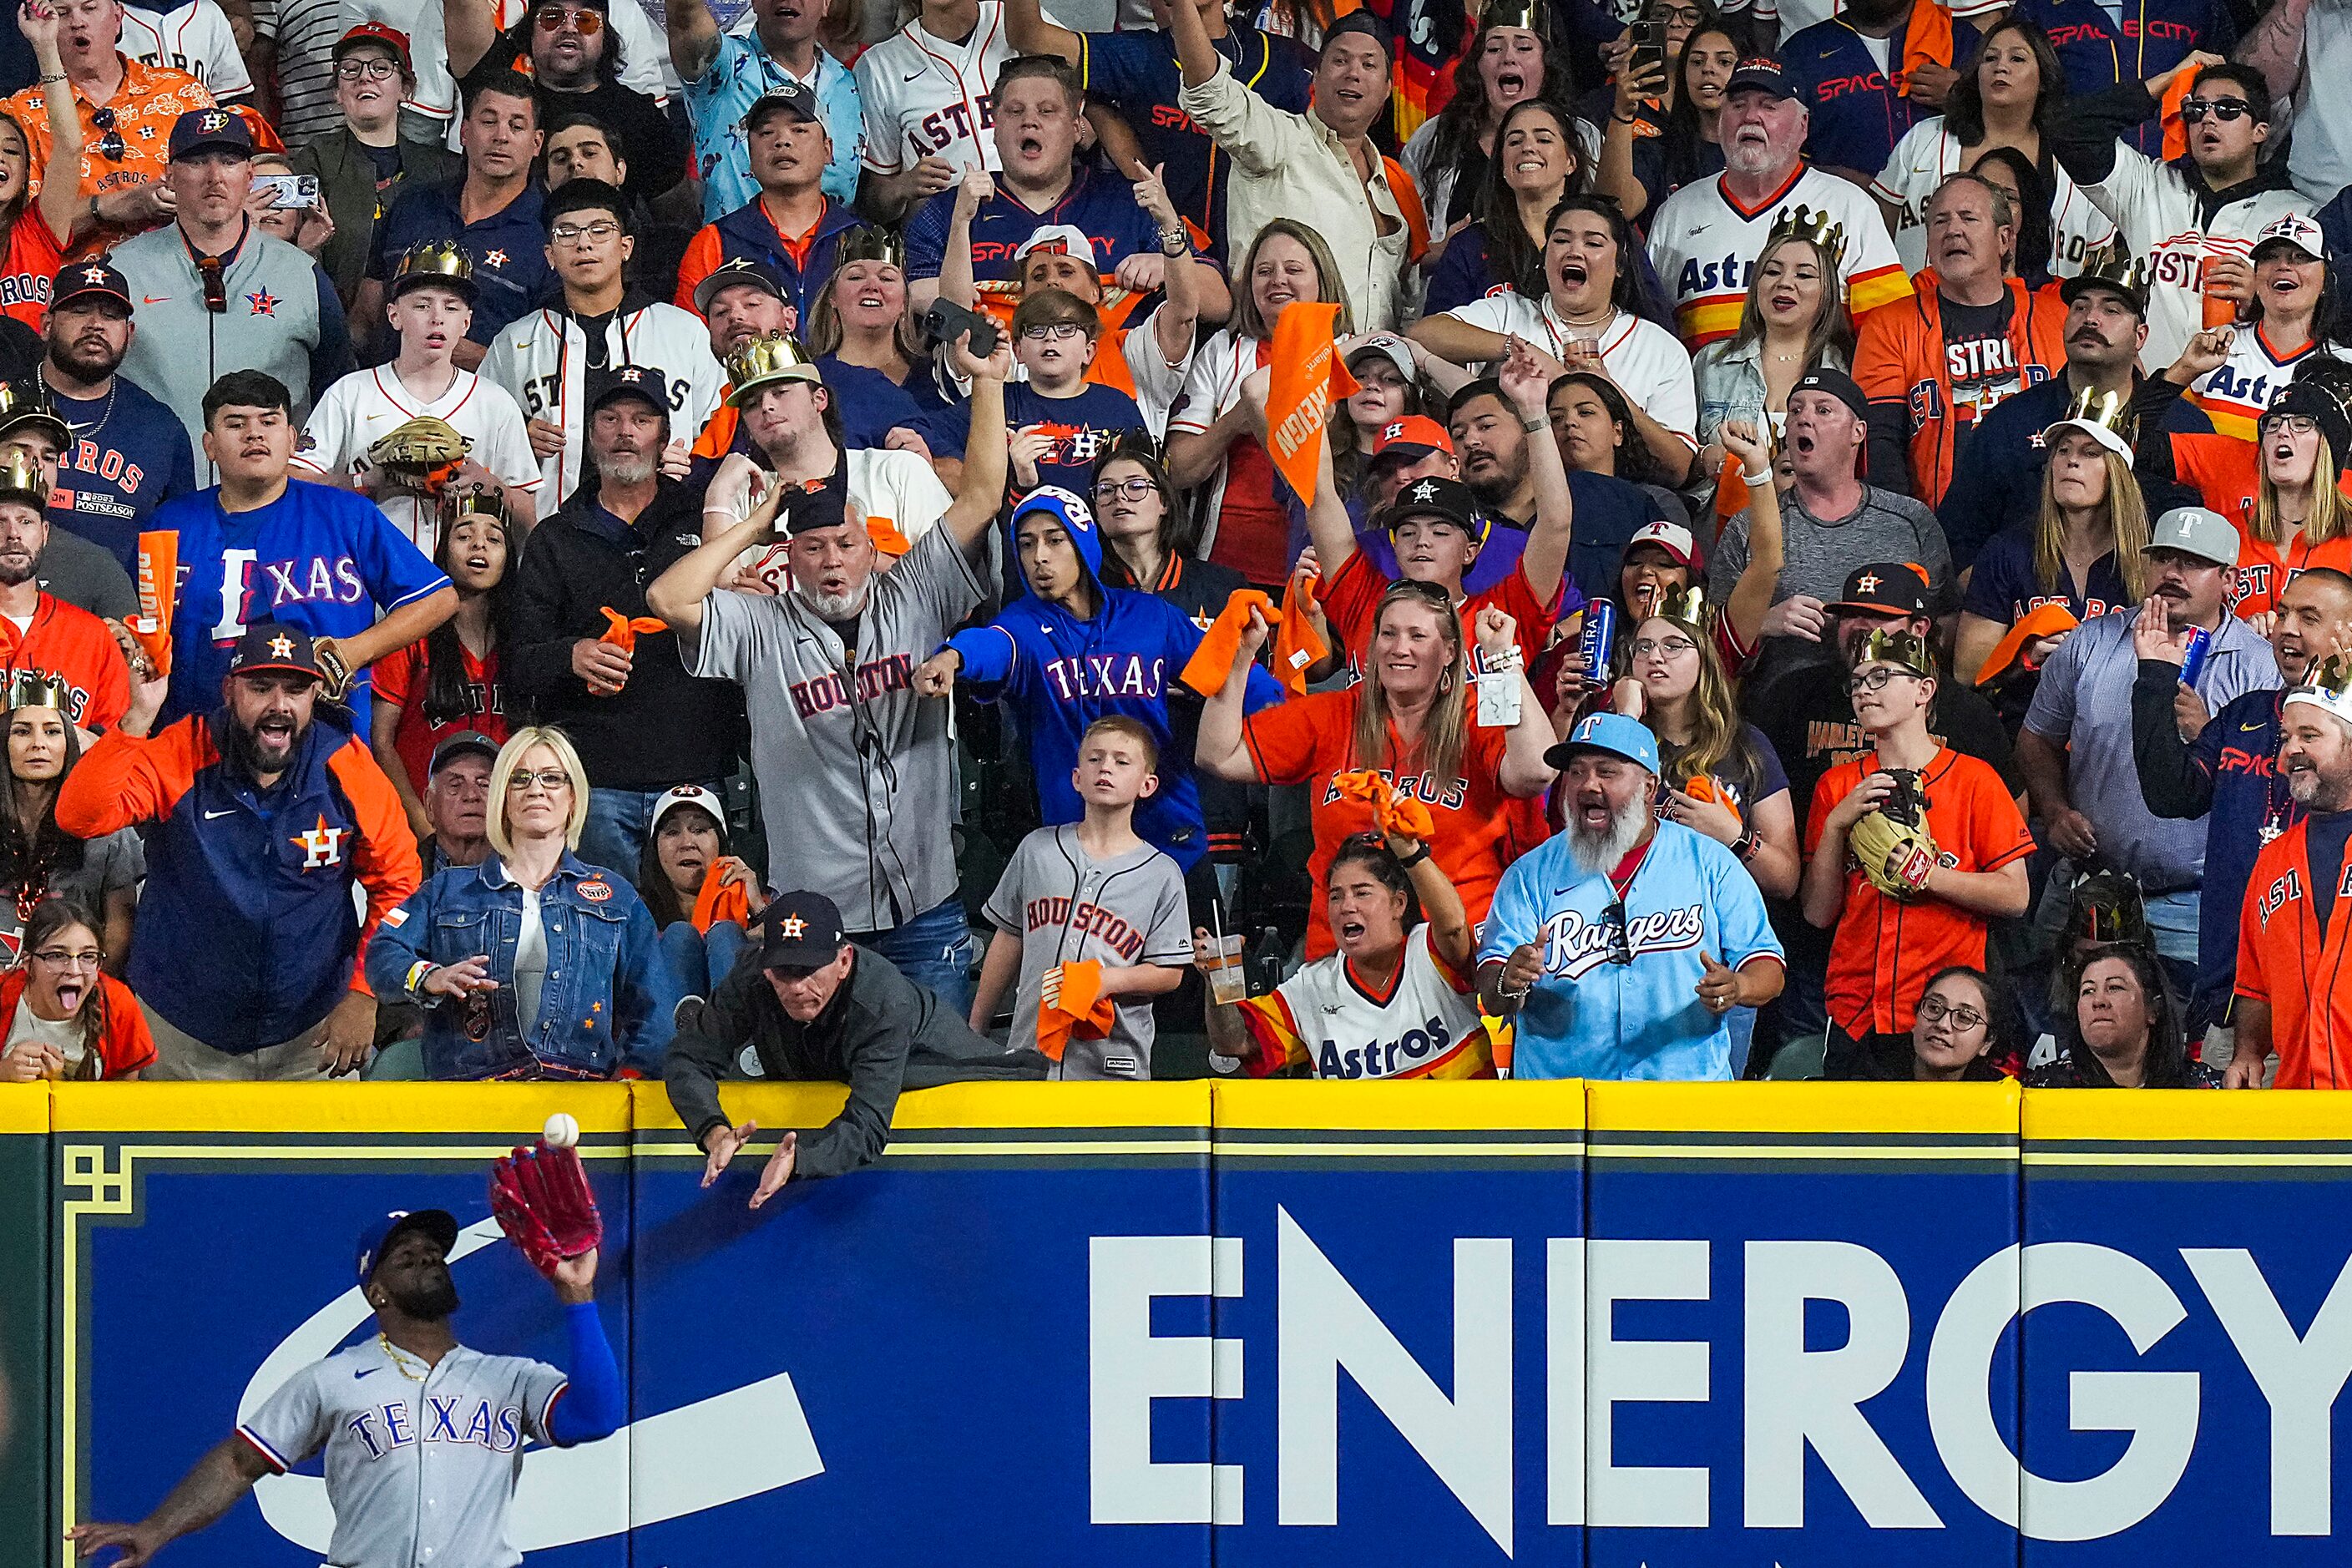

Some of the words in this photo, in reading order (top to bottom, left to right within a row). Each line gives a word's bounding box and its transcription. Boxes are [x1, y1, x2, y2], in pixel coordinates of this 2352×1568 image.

[2147, 20, 2199, 44] CITY
[97, 171, 149, 191] ASTROS
[85, 267, 105, 285] H
[0, 273, 50, 306] ROS
[251, 293, 276, 314] H
[1306, 344, 1333, 371] reliant
[621, 370, 641, 382] H
[1383, 422, 1404, 441] H
[1073, 433, 1098, 458] H
[76, 500, 136, 518] POSTSEASON
[1649, 522, 1669, 536] T
[2177, 512, 2203, 539] T
[1857, 576, 1878, 593] H
[271, 638, 292, 660] H
[1583, 618, 1598, 665] ULTRA
[1046, 655, 1165, 699] TEXAS
[1580, 716, 1601, 740] T
[1323, 769, 1468, 811] AROS
[303, 827, 342, 867] H
[782, 919, 804, 938] H
[1027, 896, 1145, 961] HOUSTON
[1318, 1015, 1451, 1079] Astros
[1090, 1202, 2352, 1560] ENERGY
[347, 1395, 523, 1461] TEXAS
